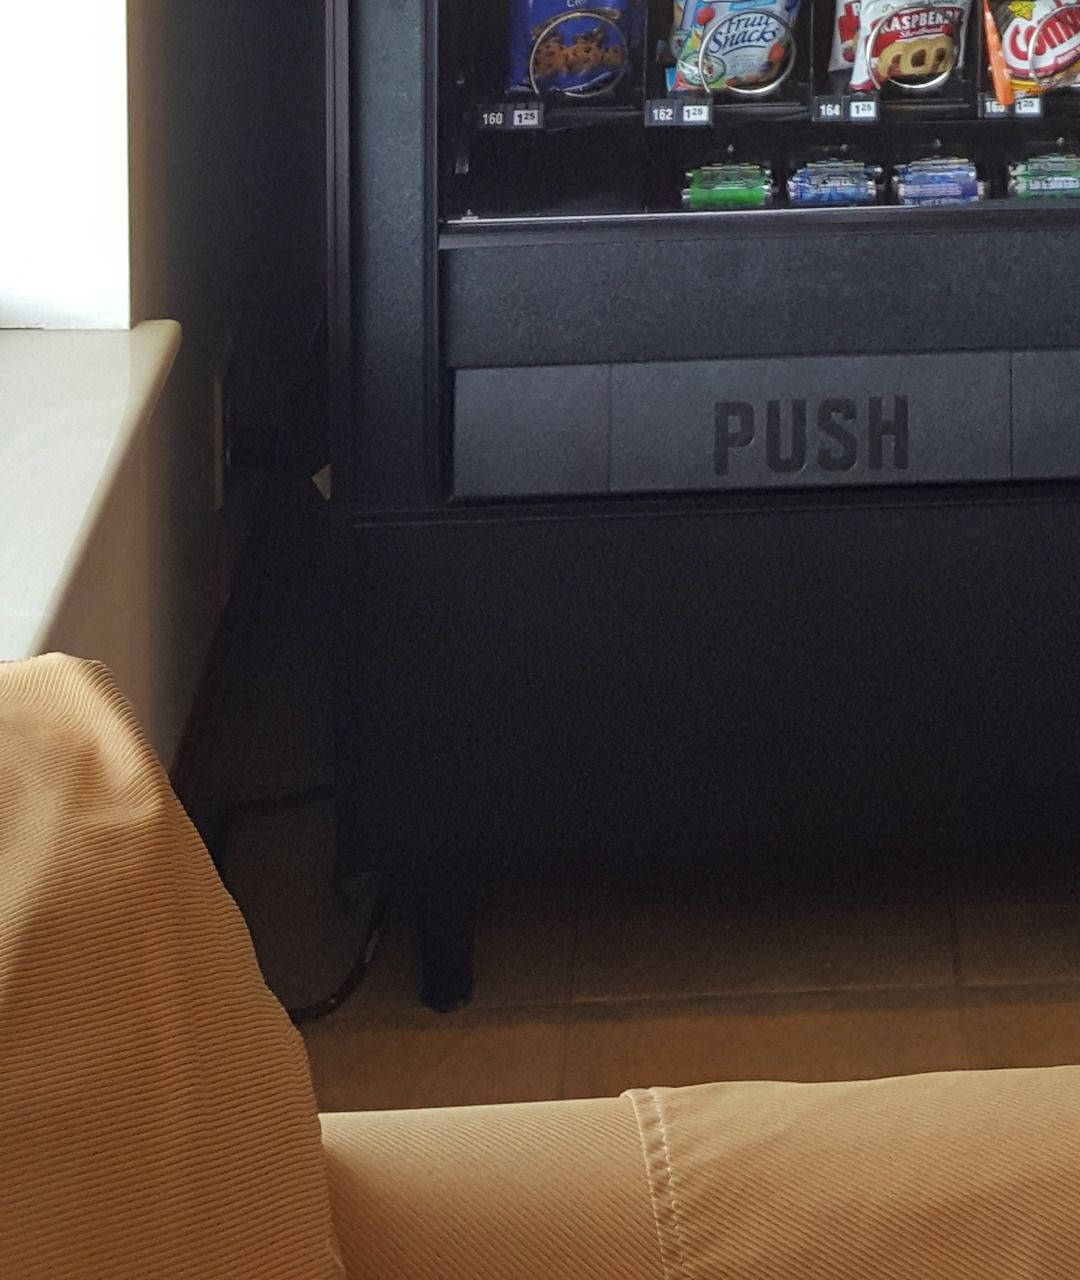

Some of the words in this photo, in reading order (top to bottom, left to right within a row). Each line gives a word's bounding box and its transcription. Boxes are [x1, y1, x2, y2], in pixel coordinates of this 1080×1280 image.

[721, 13, 773, 34] Fruit
[709, 27, 781, 54] Snacks
[482, 112, 504, 125] 160
[652, 108, 673, 120] 162
[819, 104, 841, 116] 164
[712, 395, 911, 477] PUSH
